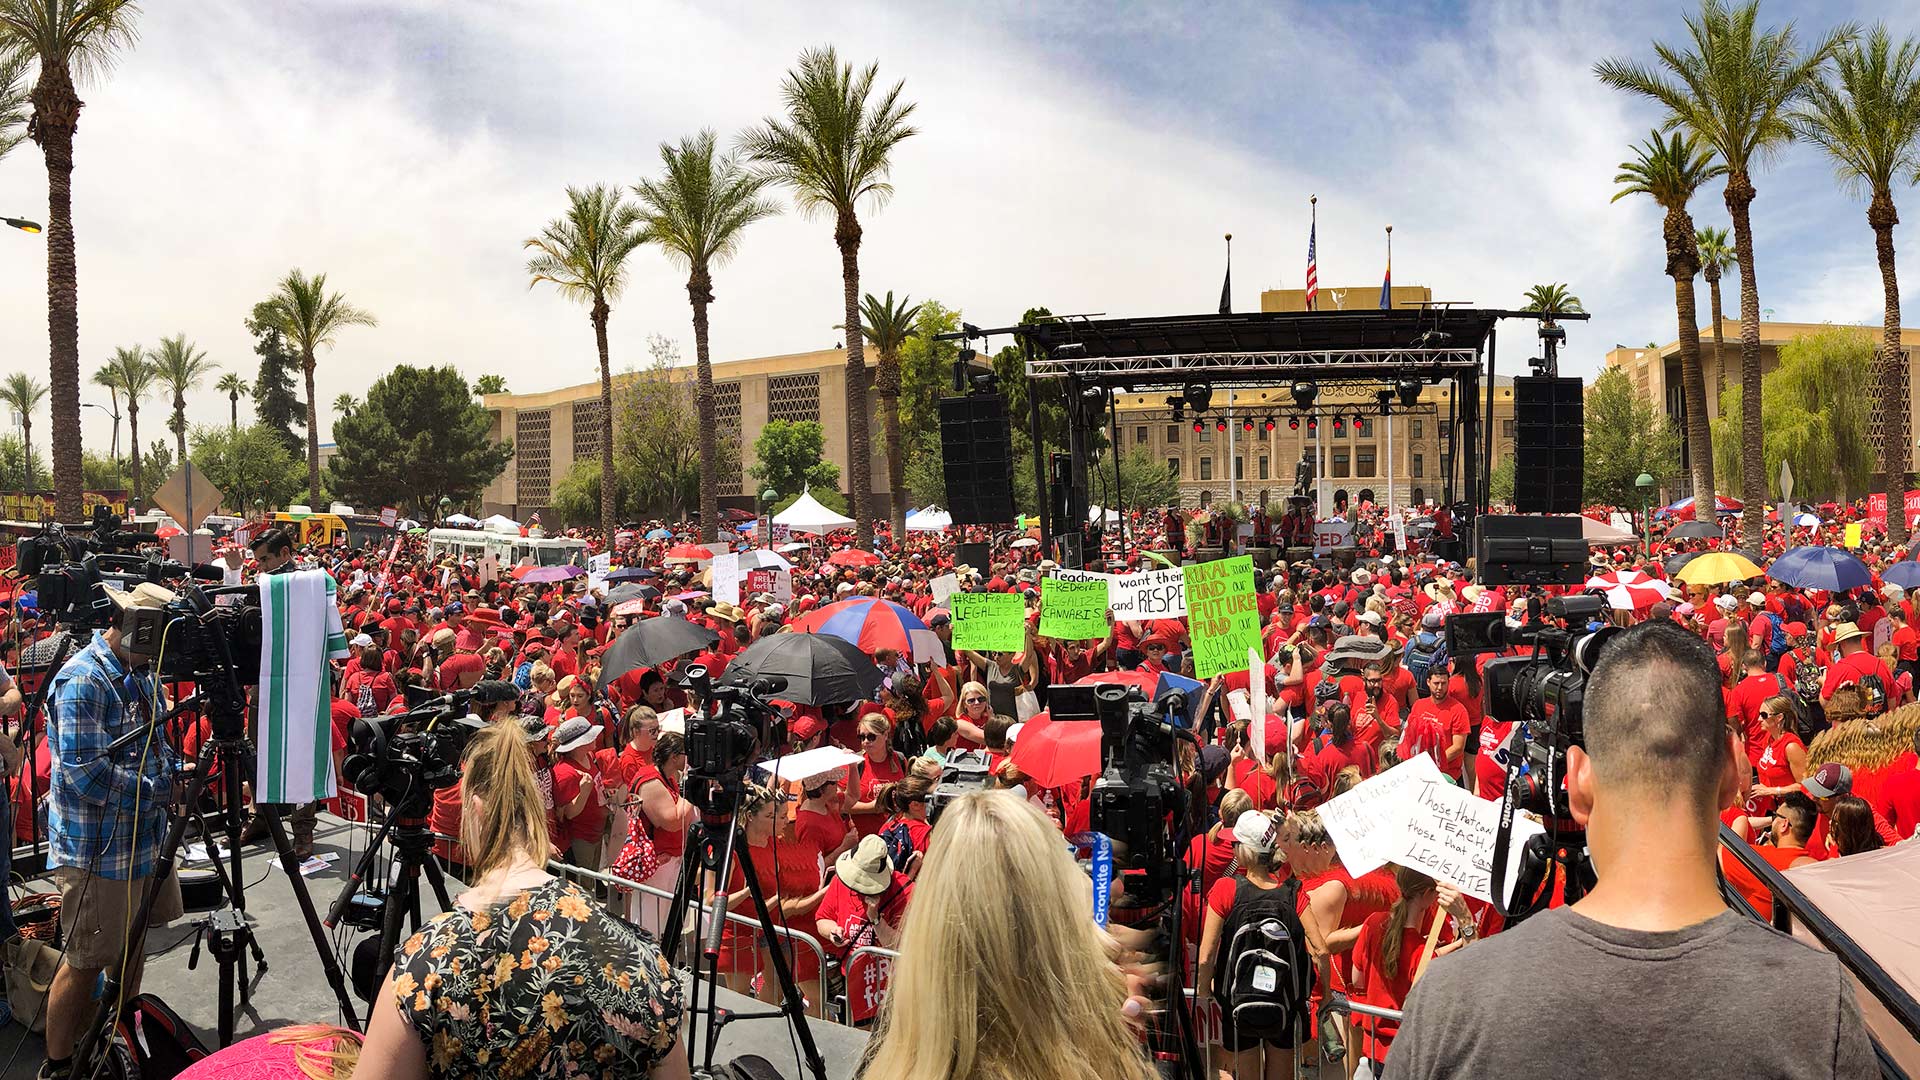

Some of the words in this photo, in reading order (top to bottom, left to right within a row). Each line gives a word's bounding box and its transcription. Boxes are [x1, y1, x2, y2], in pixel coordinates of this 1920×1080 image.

[1120, 577, 1151, 588] want
[1155, 571, 1184, 584] their
[1185, 561, 1230, 584] RURAL
[1045, 593, 1106, 607] LEGALIZE
[1111, 595, 1134, 611] and
[1138, 584, 1186, 613] RESPE
[1187, 580, 1227, 602] FUND
[1232, 580, 1247, 592] our
[955, 605, 1022, 621] LEGALIZE
[1190, 592, 1257, 621] FUTURE
[1192, 617, 1231, 641] FUND
[1418, 779, 1451, 815] Those
[1455, 800, 1476, 825] that
[1501, 765, 1520, 829] Paasonic
[1408, 818, 1436, 841] those
[1445, 835, 1467, 855] that
[1095, 864, 1109, 923] Cronkite
